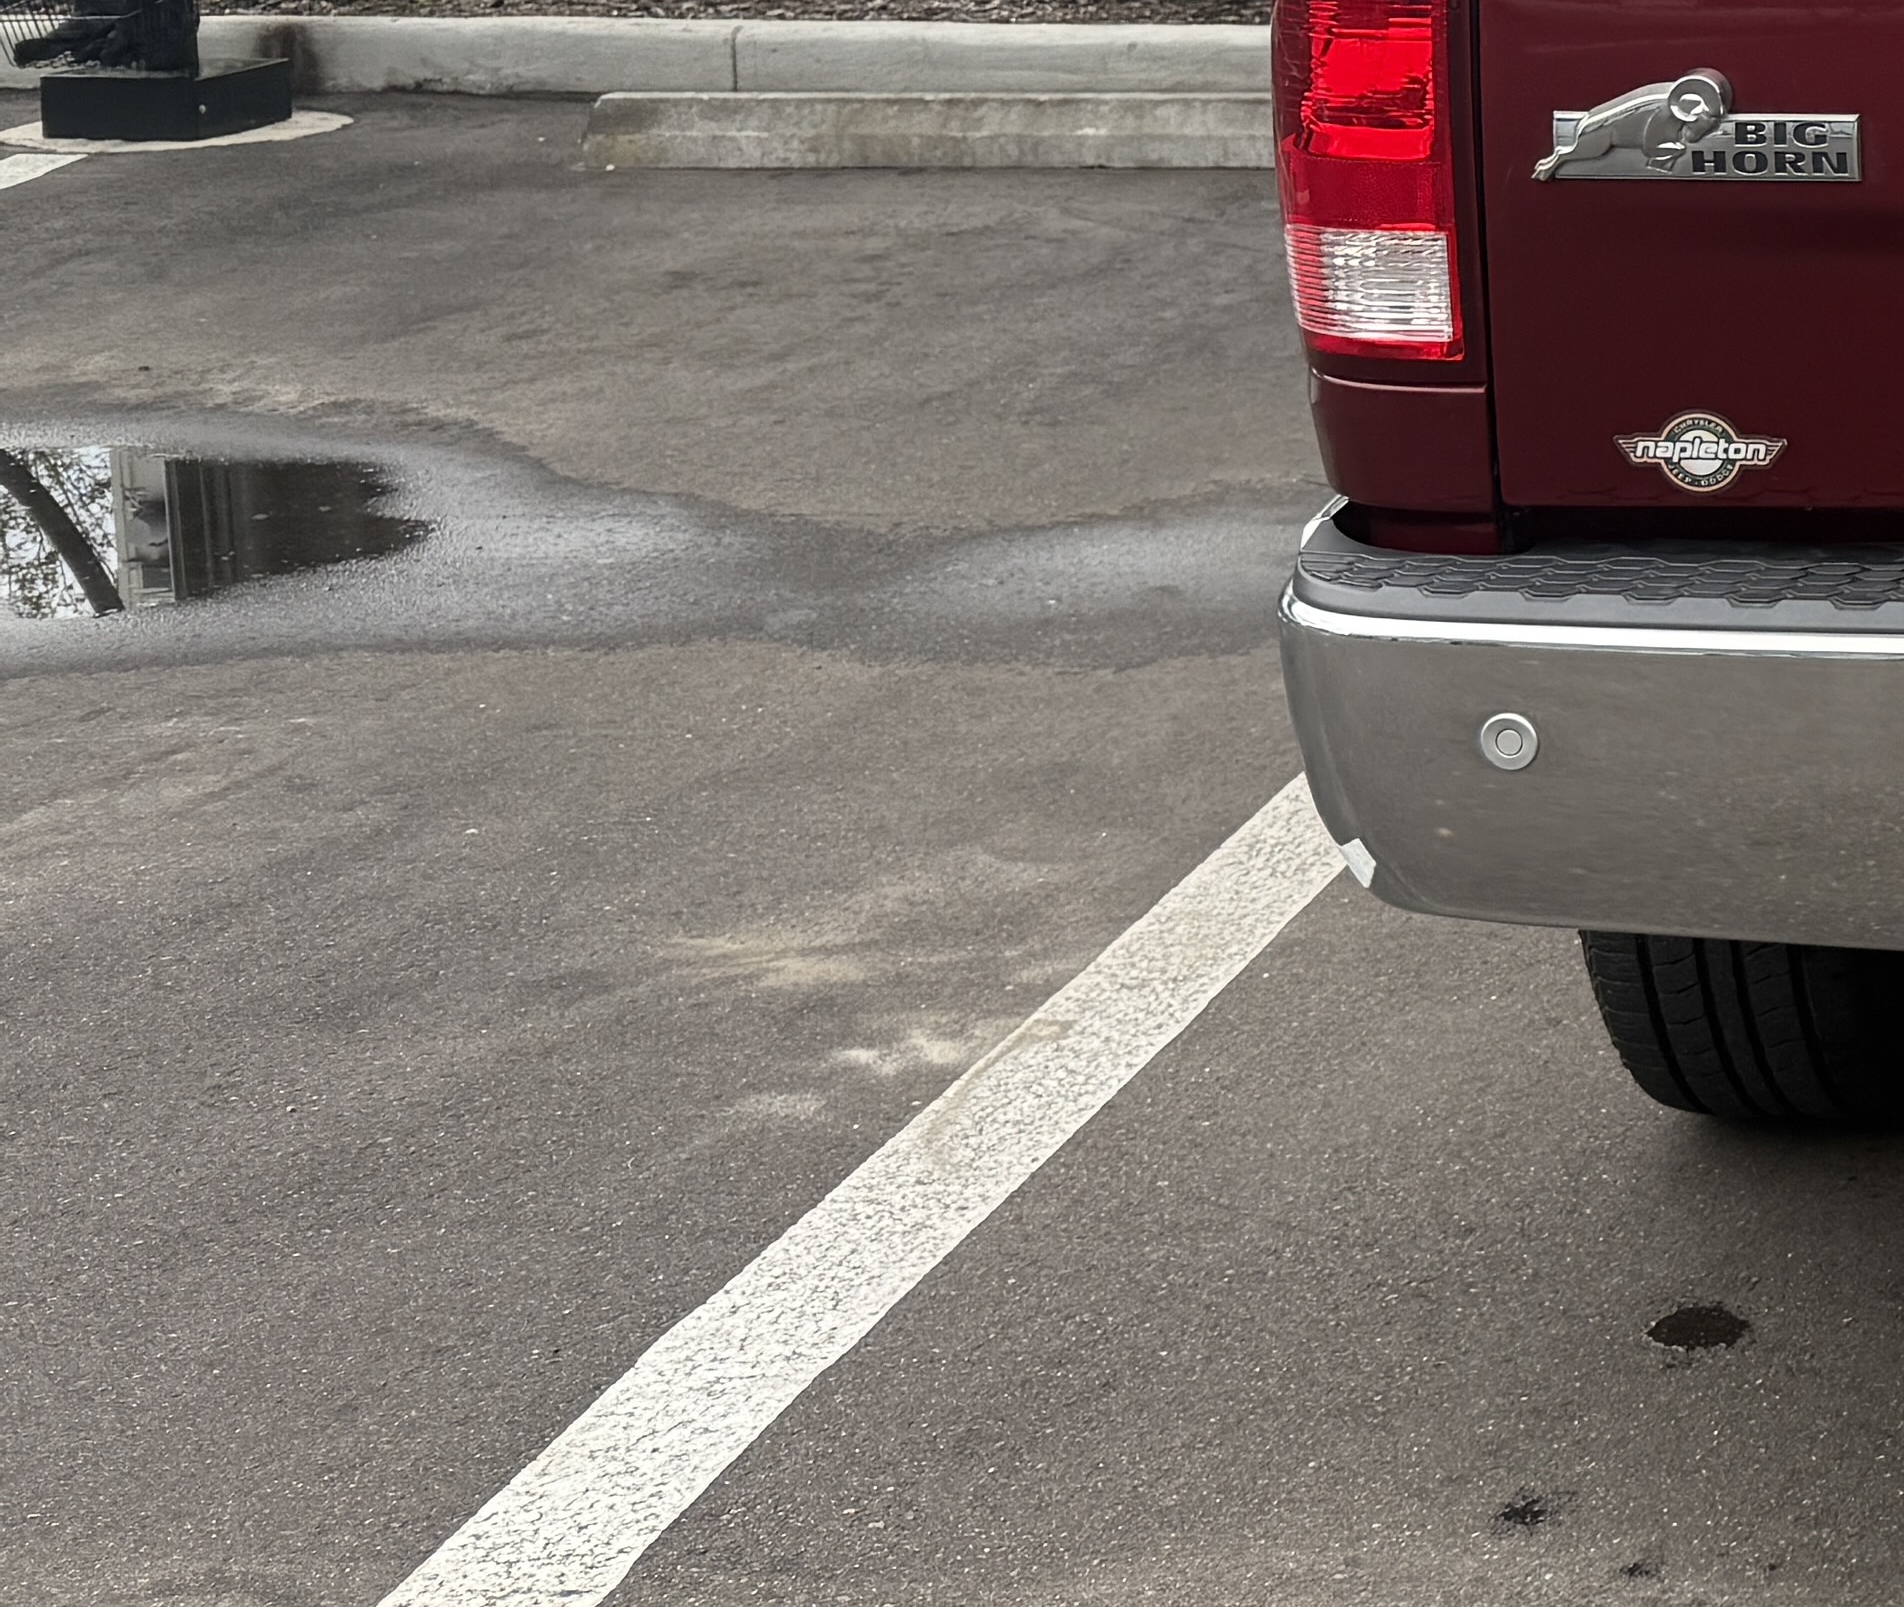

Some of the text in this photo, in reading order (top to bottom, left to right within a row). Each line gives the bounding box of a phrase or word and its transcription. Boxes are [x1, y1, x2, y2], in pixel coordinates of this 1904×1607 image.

[1734, 121, 1829, 148] BIG
[1691, 150, 1849, 176] HORN
[1636, 437, 1767, 463] napleton
